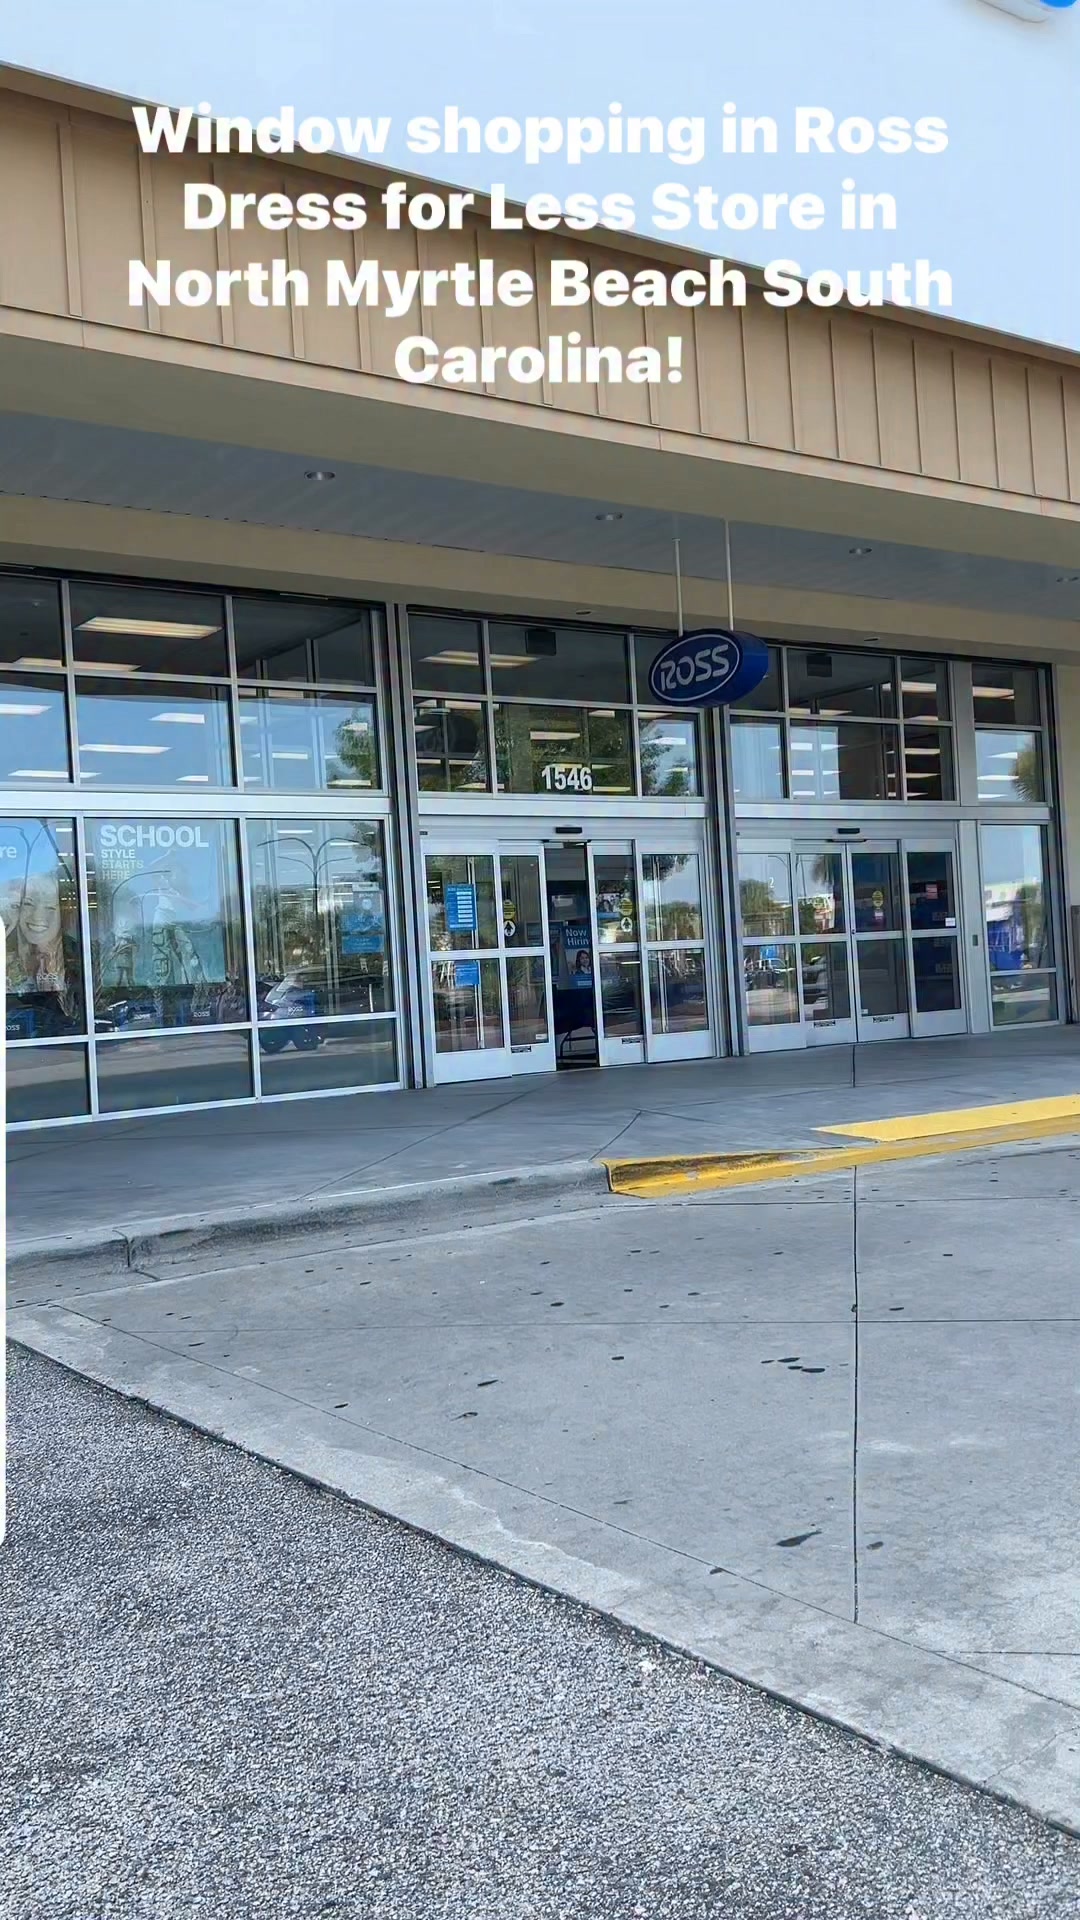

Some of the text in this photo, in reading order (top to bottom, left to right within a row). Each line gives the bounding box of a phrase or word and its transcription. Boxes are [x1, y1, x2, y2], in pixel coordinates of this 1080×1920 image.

[660, 644, 730, 692] ROSS
[541, 765, 593, 791] 1546
[100, 824, 209, 848] SCHOOL
[101, 849, 136, 859] STYLE
[102, 859, 144, 870] STARTS
[102, 870, 131, 880] HERE
[565, 928, 587, 937] Now
[567, 936, 590, 946] Hirin
